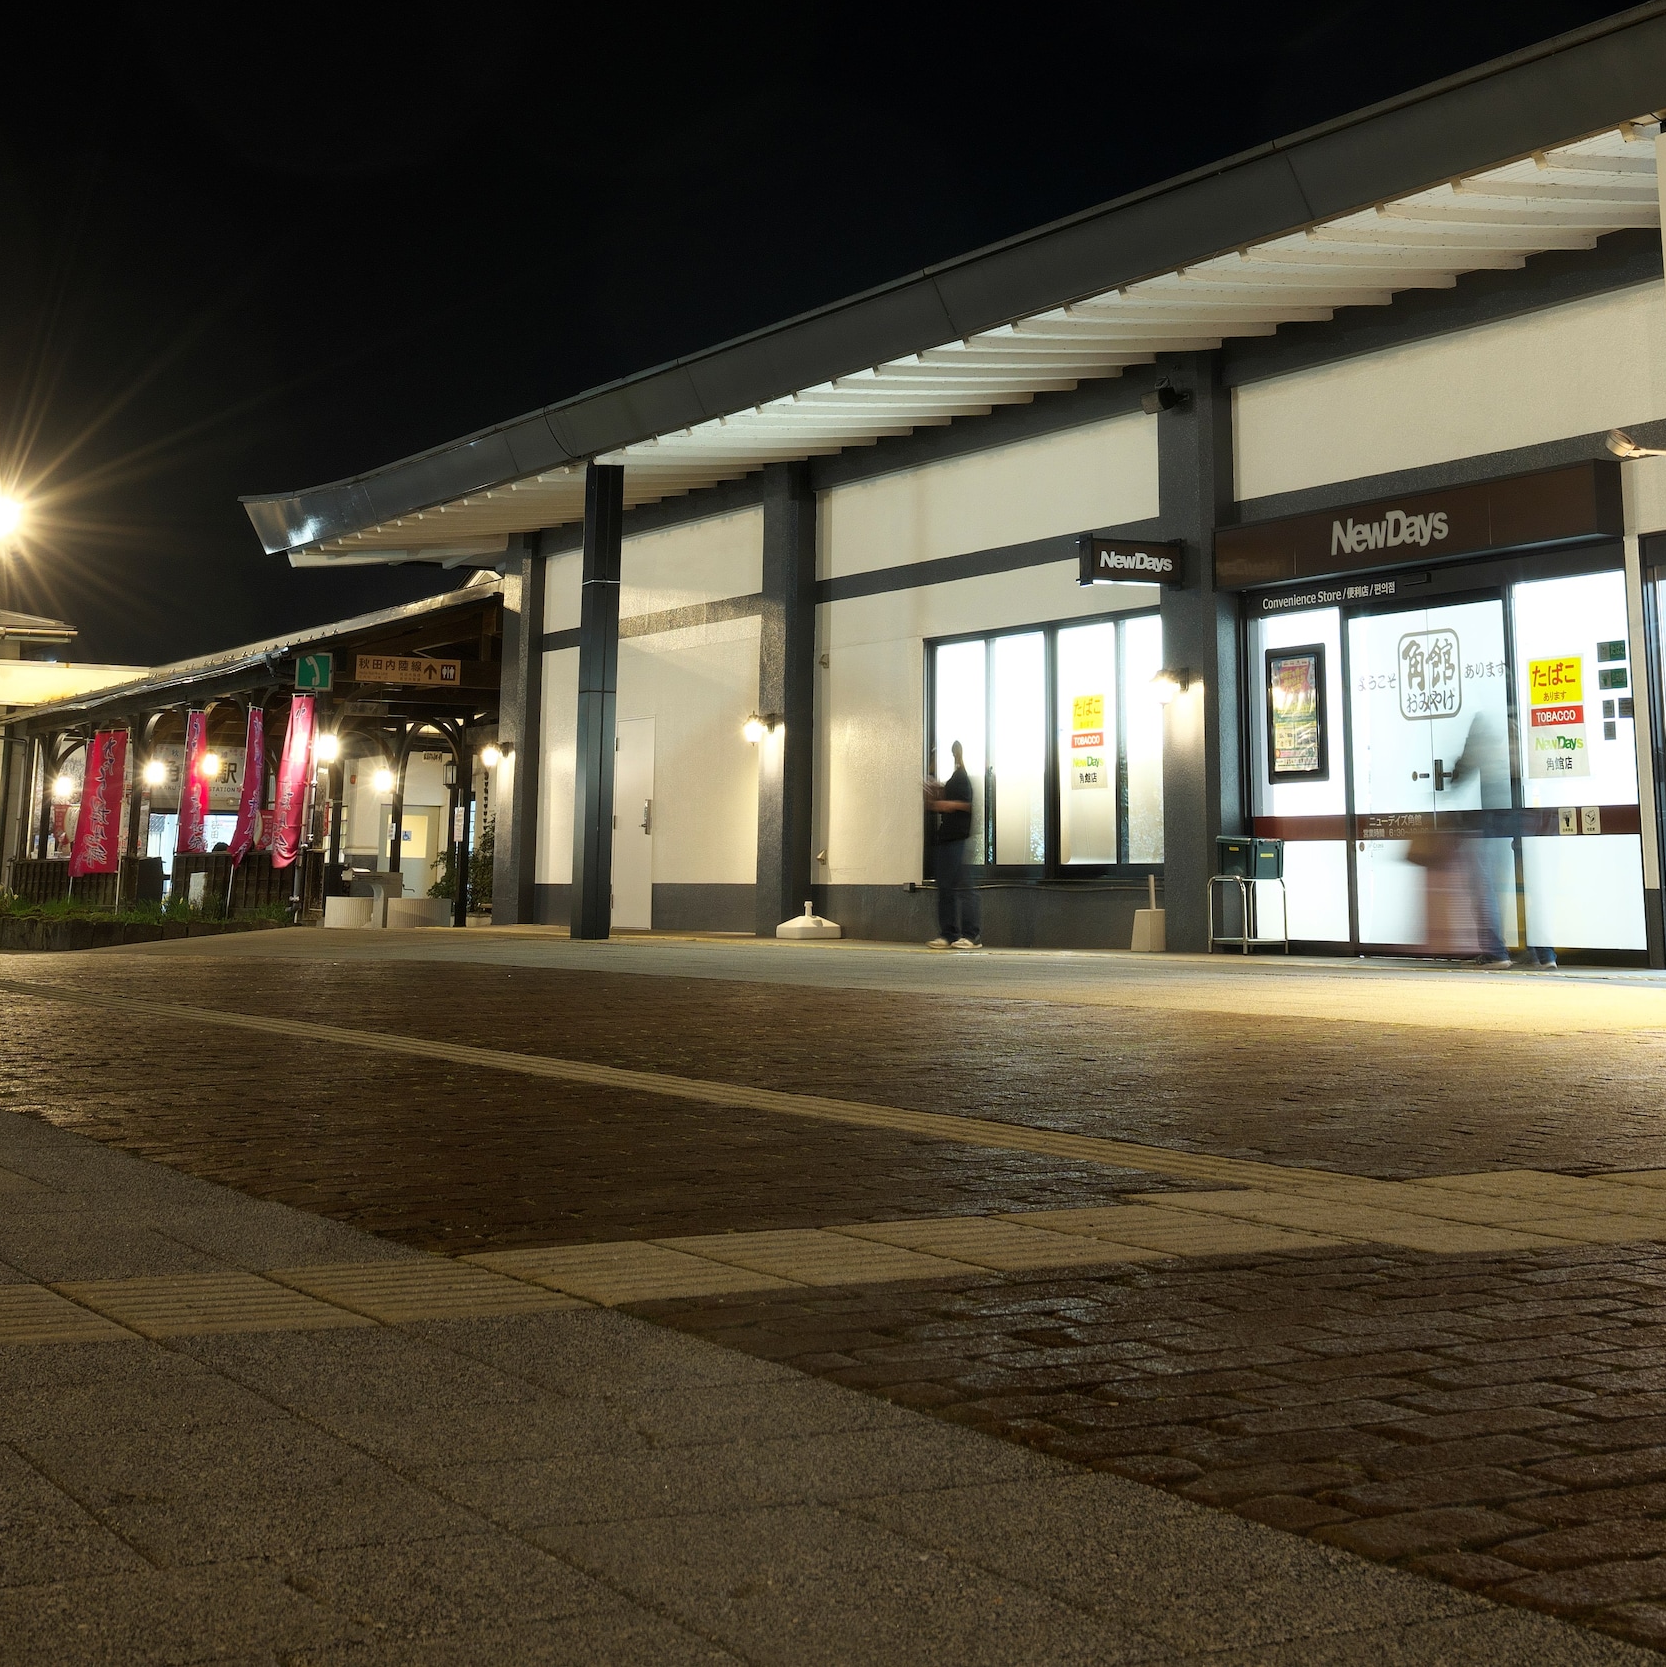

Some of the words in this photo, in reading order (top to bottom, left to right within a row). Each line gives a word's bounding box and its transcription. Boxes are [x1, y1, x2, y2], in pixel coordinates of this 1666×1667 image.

[1331, 509, 1449, 556] NewDays
[1099, 550, 1173, 572] NewDays
[1262, 592, 1316, 610] Convenience
[359, 658, 422, 672] 秋田内陸線
[1402, 638, 1456, 691] 角館
[1357, 673, 1397, 692] ようこそ
[1532, 662, 1575, 687] たばこ
[1406, 689, 1455, 713] おみやげ
[1543, 690, 1567, 701] あります
[1074, 698, 1101, 717] たばこ
[1536, 709, 1576, 722] TOBACCO
[1074, 735, 1100, 746] TOBACCO
[1535, 736, 1584, 750] NewDays
[1072, 756, 1104, 767] NewDays
[1546, 756, 1573, 771] 角館店
[1369, 814, 1422, 826] ニューデイズ角館
